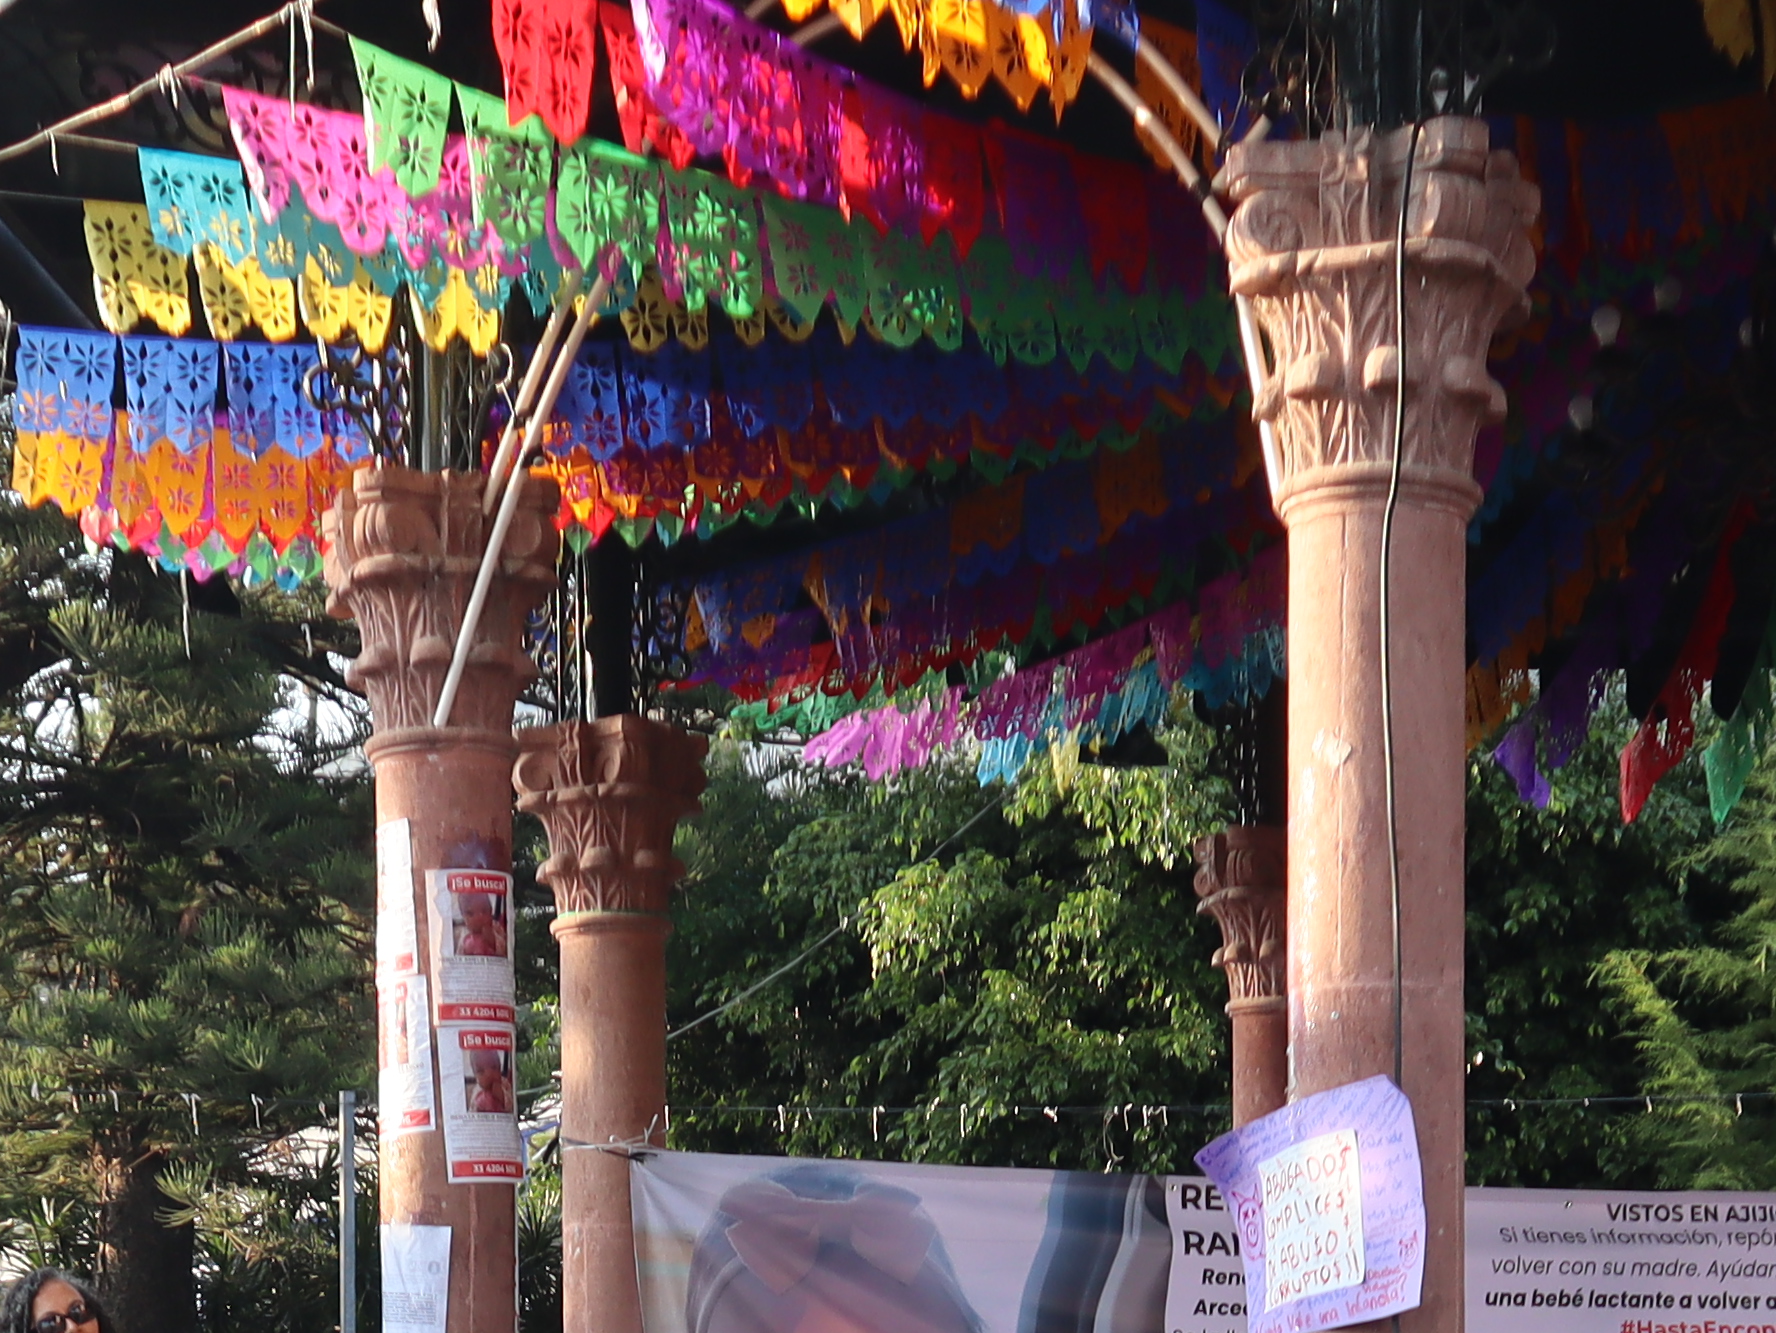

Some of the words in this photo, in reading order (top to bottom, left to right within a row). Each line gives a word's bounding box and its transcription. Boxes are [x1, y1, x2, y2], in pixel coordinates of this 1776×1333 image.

[485, 1033, 511, 1047] busca
[1181, 1184, 1228, 1211] RE
[1606, 1203, 1684, 1222] VISTOS
[1690, 1204, 1719, 1223] EN
[1499, 1227, 1517, 1244] Si
[1523, 1227, 1587, 1245] tienes
[1591, 1228, 1723, 1248] información,
[1491, 1255, 1554, 1276] volver
[1558, 1260, 1597, 1276] con
[1602, 1260, 1625, 1276] su
[1630, 1258, 1702, 1277] madre.
[1485, 1291, 1527, 1307] una
[1531, 1287, 1584, 1308] bebé
[1588, 1290, 1675, 1309] lactante
[1679, 1295, 1692, 1309] a
[1698, 1291, 1761, 1310] volver
